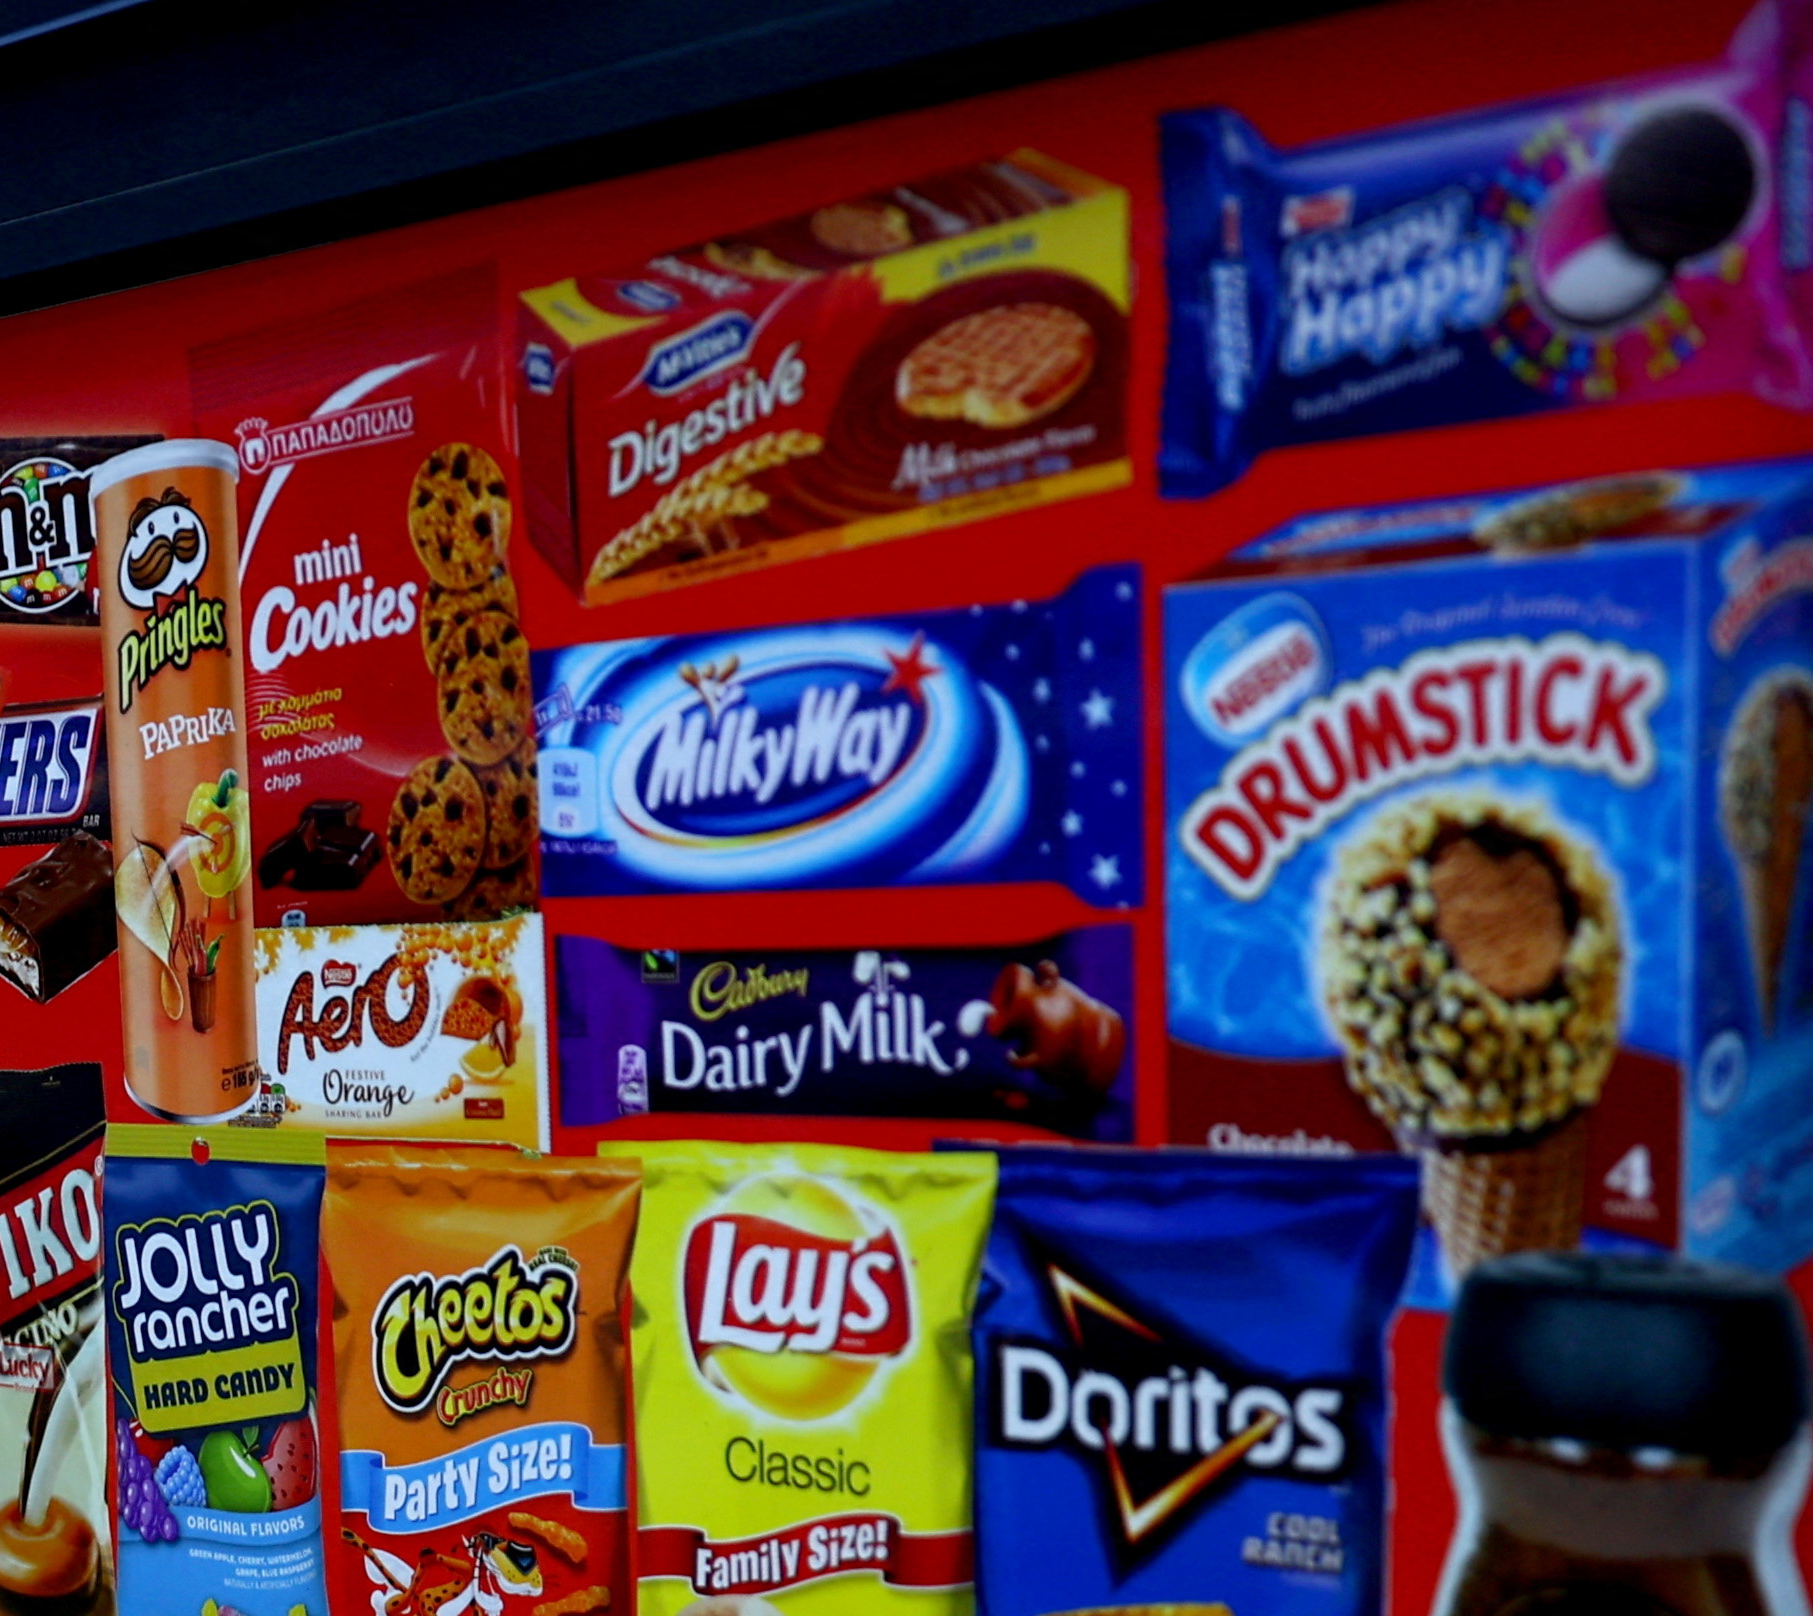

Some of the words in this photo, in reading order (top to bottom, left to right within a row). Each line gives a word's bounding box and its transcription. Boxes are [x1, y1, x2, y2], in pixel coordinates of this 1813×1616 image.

[1292, 196, 1462, 298] Happy
[1290, 246, 1505, 362] Happy
[607, 341, 807, 497] Digestive
[294, 533, 363, 585] mini
[121, 593, 223, 711] Pringles
[250, 576, 418, 673] Cookies
[140, 706, 237, 759] PAPRIKA
[261, 750, 291, 768] with
[295, 735, 363, 762] chocolate
[264, 772, 302, 793] chips
[1197, 655, 1650, 884] DRUMSTICK
[82, 814, 100, 828] BAR
[690, 961, 809, 1022] Cadbury
[661, 1020, 813, 1096] Dairy
[821, 990, 954, 1076] Milk
[322, 1068, 415, 1117] Orange
[346, 1069, 386, 1081] FESTIVE
[326, 1109, 361, 1119] SHARING
[363, 1108, 382, 1119] BAR
[1605, 1144, 1653, 1199] 4
[121, 1214, 269, 1309] JOLLY
[528, 1256, 548, 1272] REAL
[698, 1220, 896, 1353] Lay's
[133, 1287, 289, 1353] rancher
[380, 1258, 568, 1400] Cheetos
[144, 1378, 208, 1409] HARD
[215, 1363, 295, 1400] CANDY
[438, 1367, 532, 1425] Crunchy
[1002, 1344, 1346, 1472] Doritos
[384, 1456, 479, 1521] Party
[488, 1434, 572, 1495] Size!
[725, 1436, 871, 1496] Classic
[187, 1516, 247, 1536] ORIGINAL
[251, 1516, 305, 1536] FLAVORS
[696, 1539, 801, 1588] Family
[807, 1519, 888, 1567] Size!
[1241, 1536, 1343, 1572] RANCH
[1268, 1511, 1340, 1543] COOL
[189, 1548, 212, 1559] GREEN
[213, 1550, 236, 1564] APPLE,
[238, 1552, 266, 1566] CHERRY,
[235, 1567, 261, 1579] GRAPE,
[262, 1567, 279, 1578] BLUE
[280, 1559, 315, 1577] RASPBERRY
